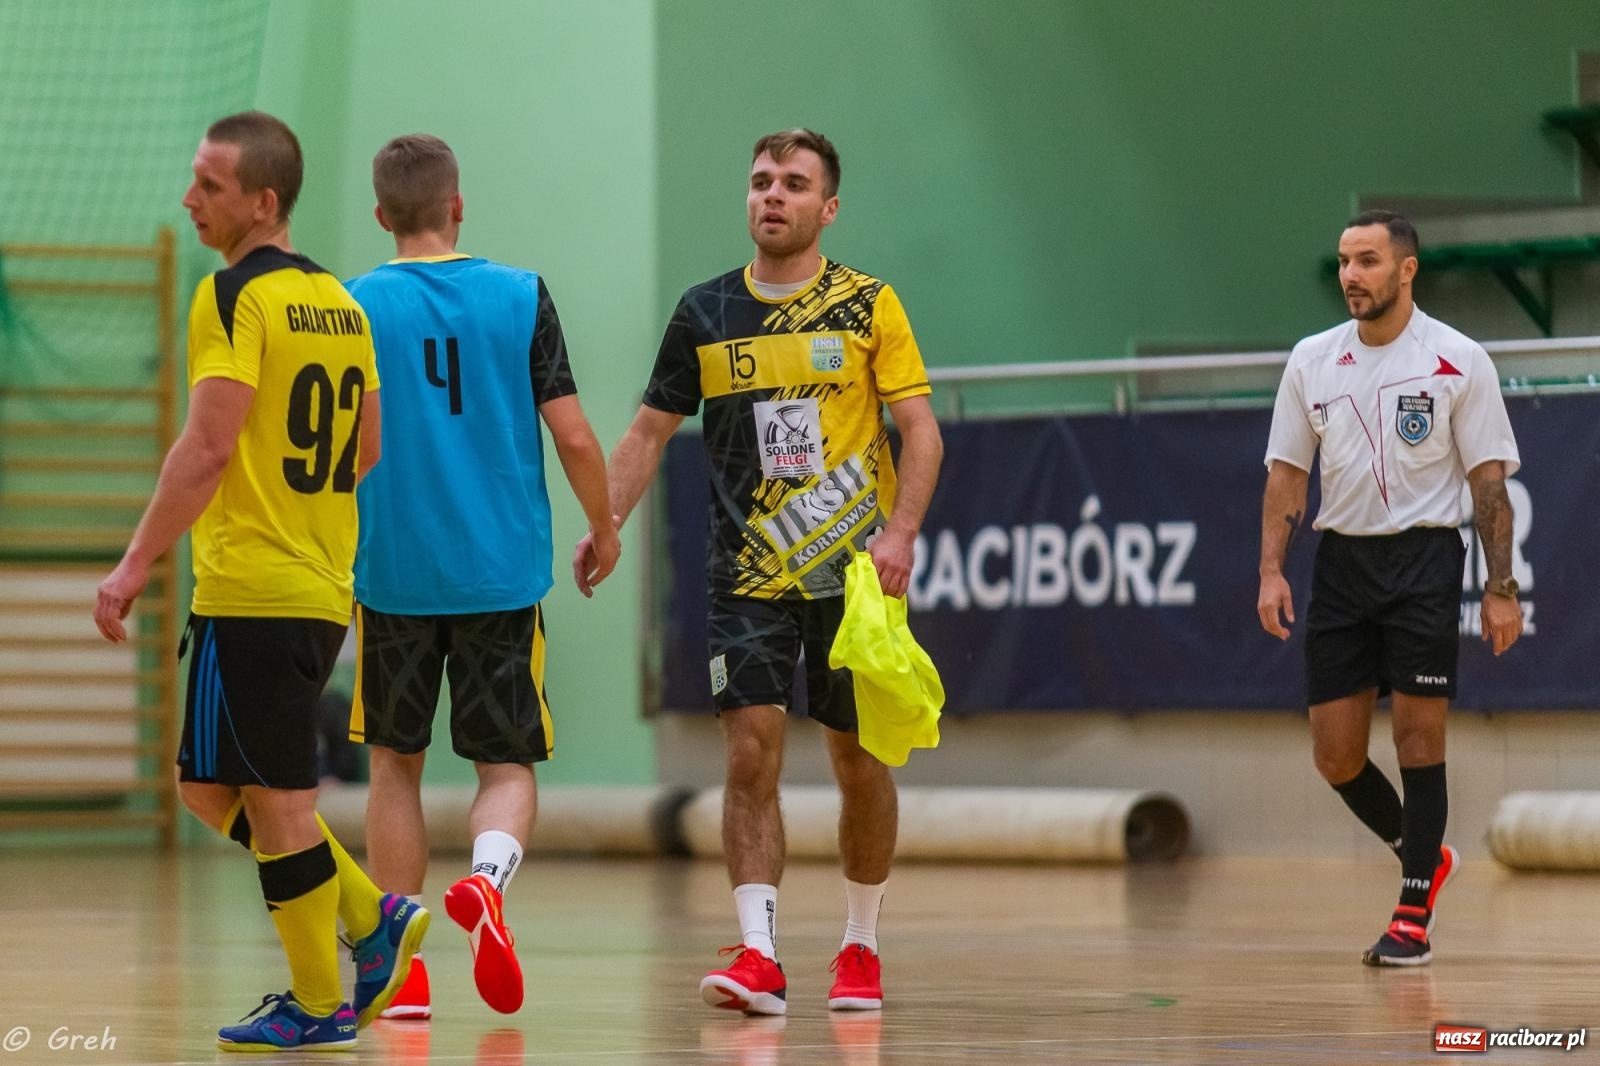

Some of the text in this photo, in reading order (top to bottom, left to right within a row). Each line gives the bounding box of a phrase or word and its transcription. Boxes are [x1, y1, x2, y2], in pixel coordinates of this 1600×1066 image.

[423, 336, 463, 416] 4
[724, 340, 756, 381] 15
[282, 362, 366, 494] 92
[766, 443, 816, 457] SOLIDNE
[775, 454, 808, 466] FELGI
[907, 494, 1198, 611] RACIBÓRZ
